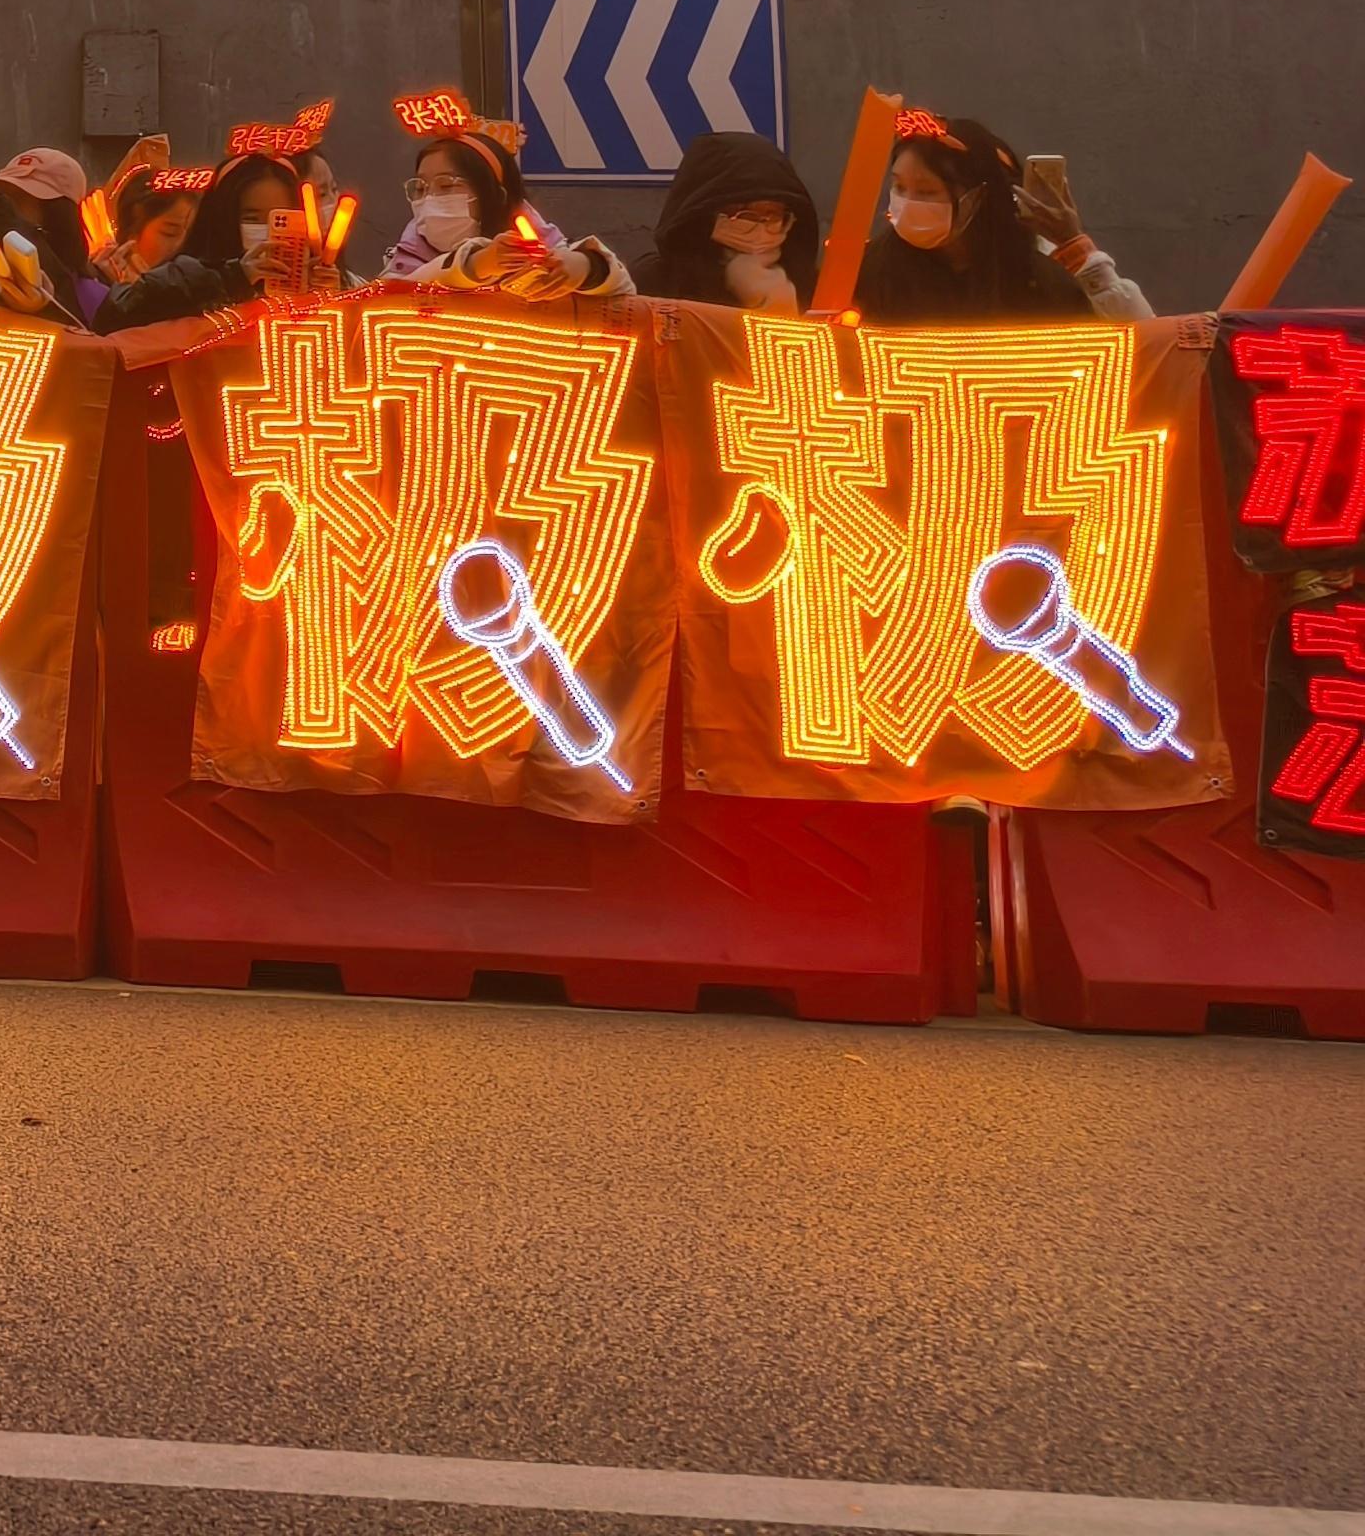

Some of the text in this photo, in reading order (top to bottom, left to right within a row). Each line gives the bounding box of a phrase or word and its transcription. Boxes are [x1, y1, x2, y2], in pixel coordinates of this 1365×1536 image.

[395, 94, 468, 134] 张极
[231, 126, 311, 154] 张极
[153, 169, 214, 190] 张极
[222, 308, 656, 760] 极
[699, 314, 1179, 771] 极
